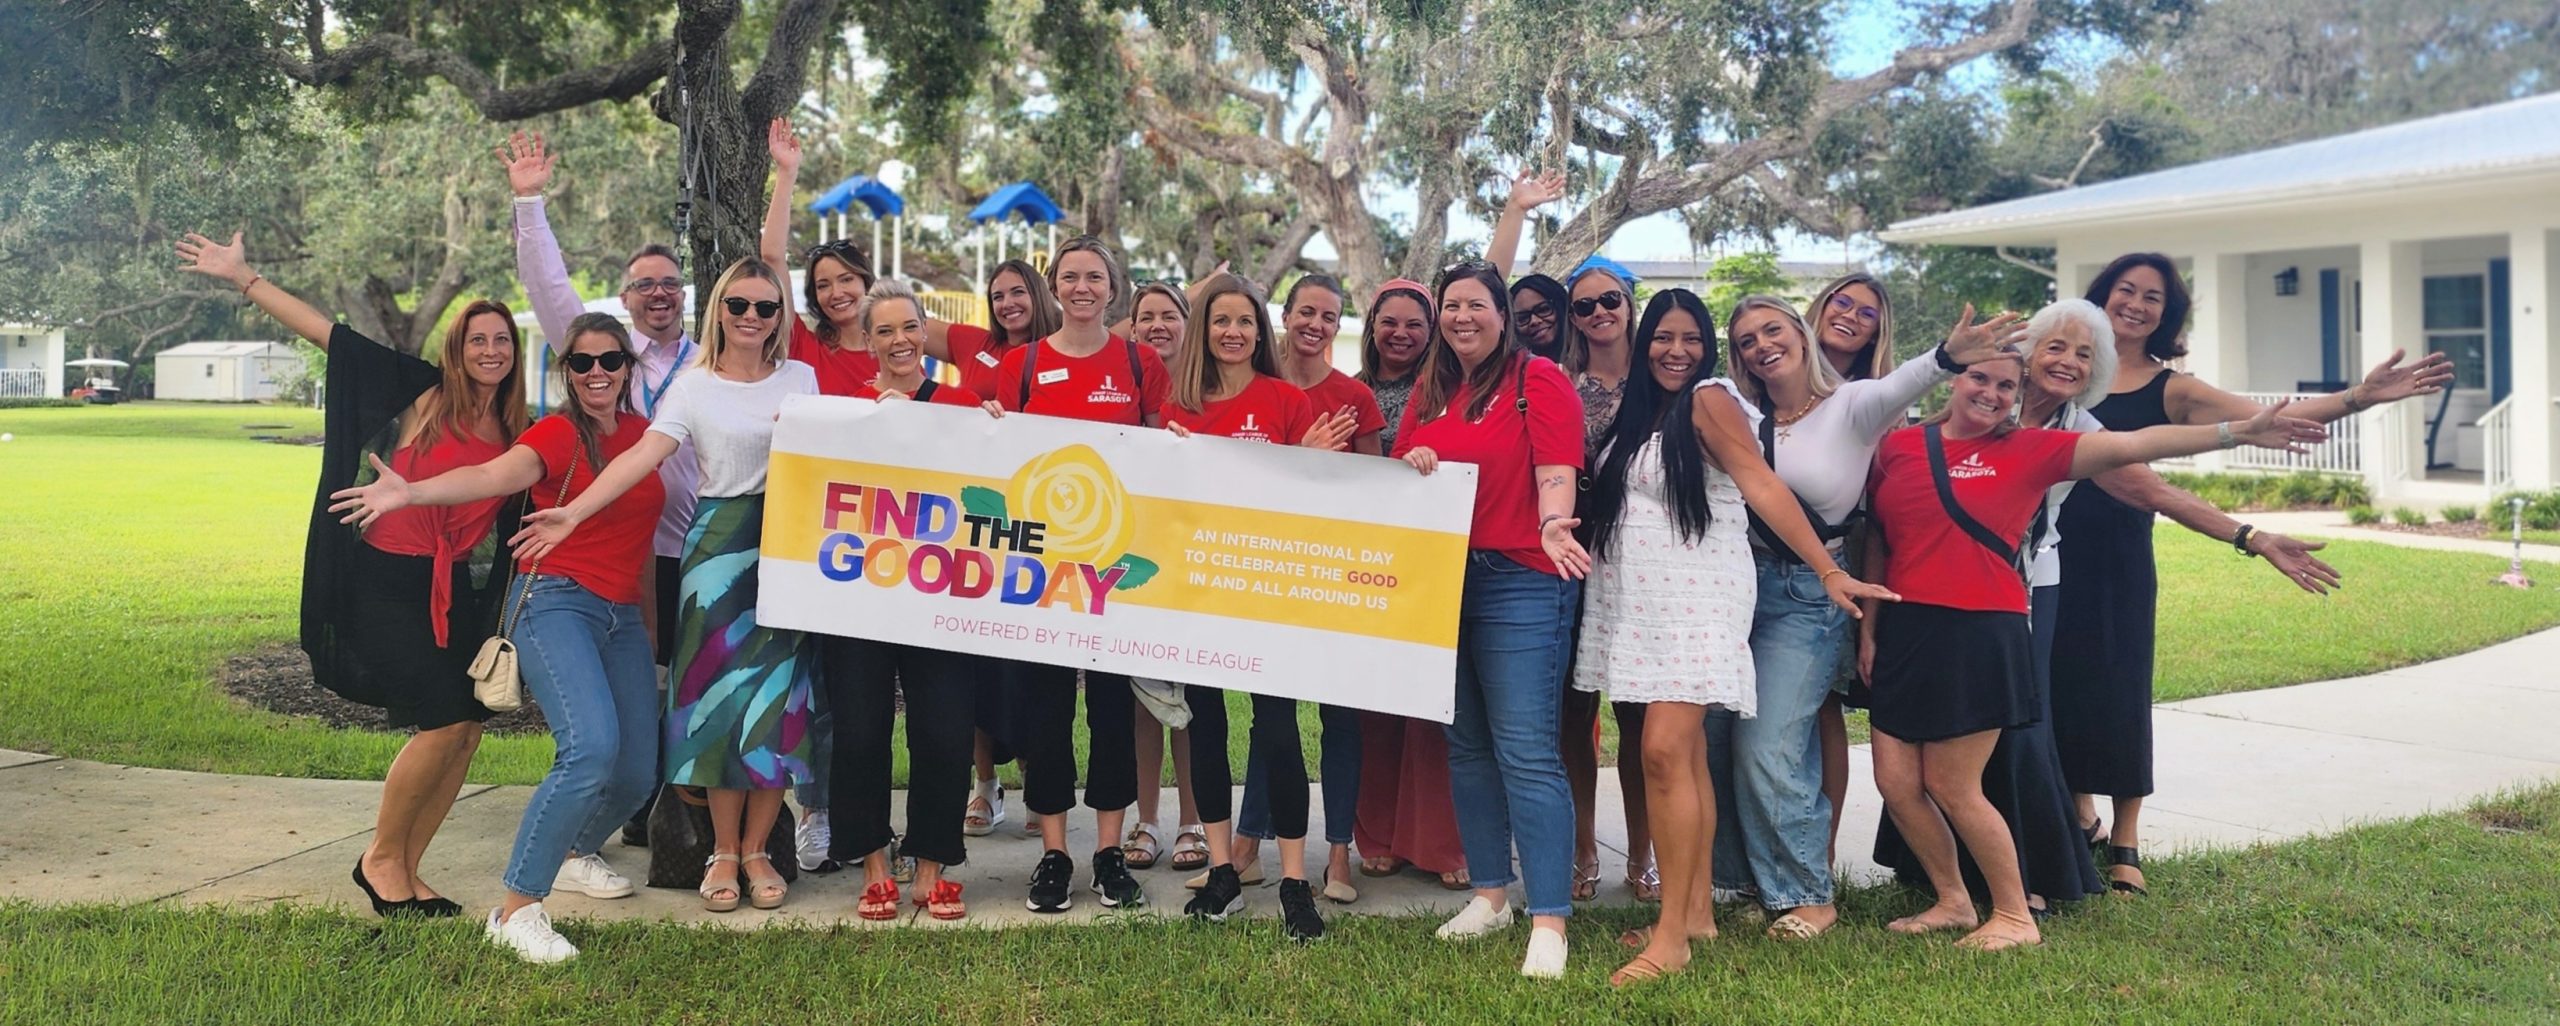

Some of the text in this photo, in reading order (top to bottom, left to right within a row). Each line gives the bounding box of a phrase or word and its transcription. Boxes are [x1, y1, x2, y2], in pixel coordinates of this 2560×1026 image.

[1088, 395, 1131, 403] SARASOTA
[822, 481, 1047, 555] FIND THE
[1193, 529, 1393, 565] AN INTERNATIONAL DAY
[818, 532, 995, 599] GOOD
[1000, 554, 1128, 616] DAY
[1184, 549, 1397, 588] TO CELEBRATE THE GOOD
[1189, 572, 1388, 610] IN AND ALL AROUND US
[934, 615, 1263, 673] POWERED BY THE JUNIOR LEAGUE
